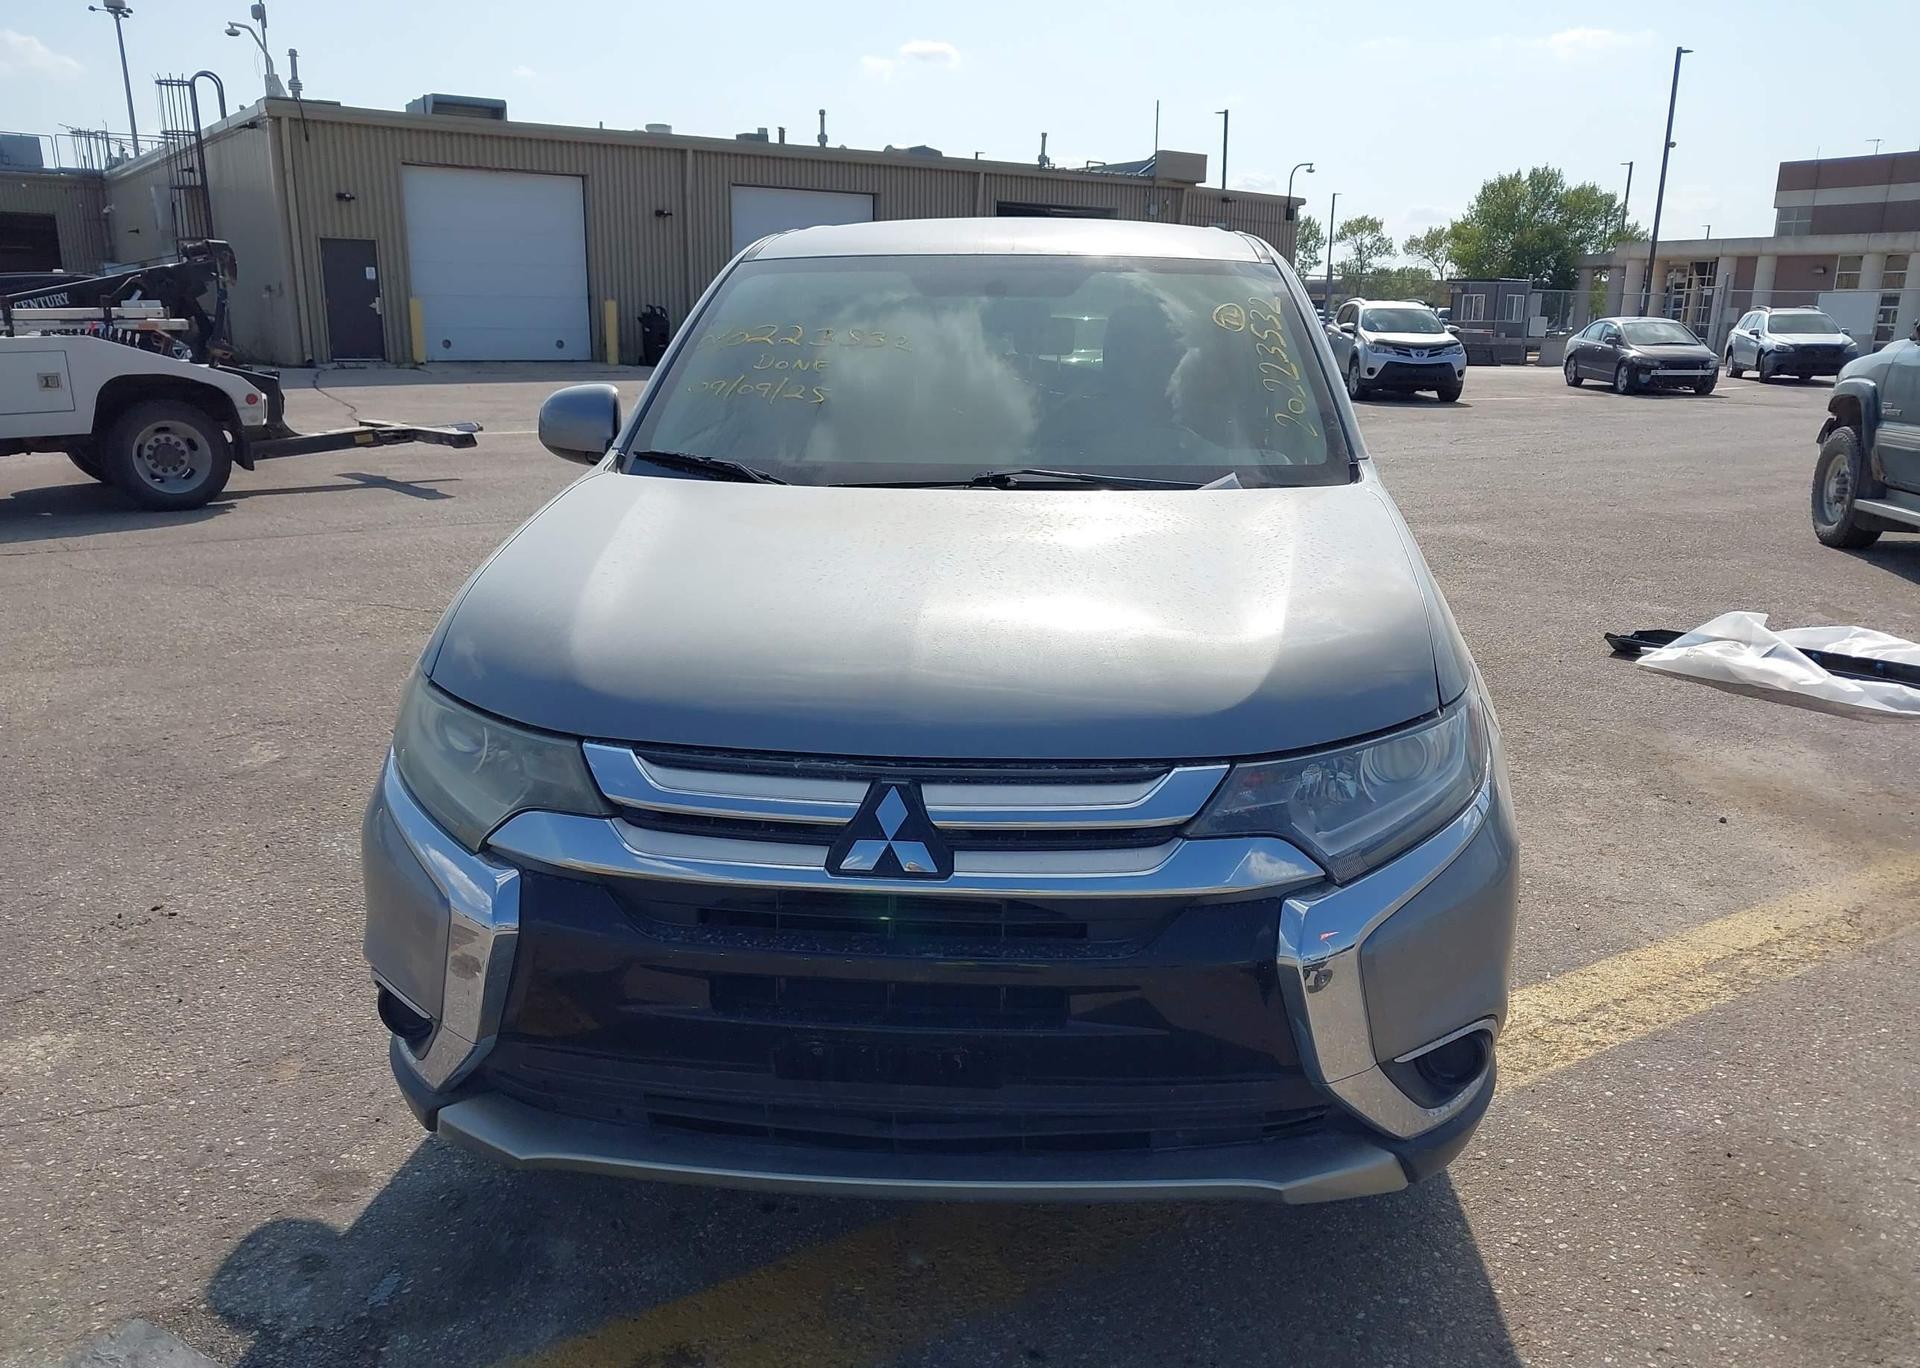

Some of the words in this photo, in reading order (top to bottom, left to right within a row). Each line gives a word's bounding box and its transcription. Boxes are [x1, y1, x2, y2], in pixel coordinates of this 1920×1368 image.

[13, 292, 71, 309] CENTURY
[752, 352, 832, 373] DONE
[1248, 297, 1318, 437] 20223532
